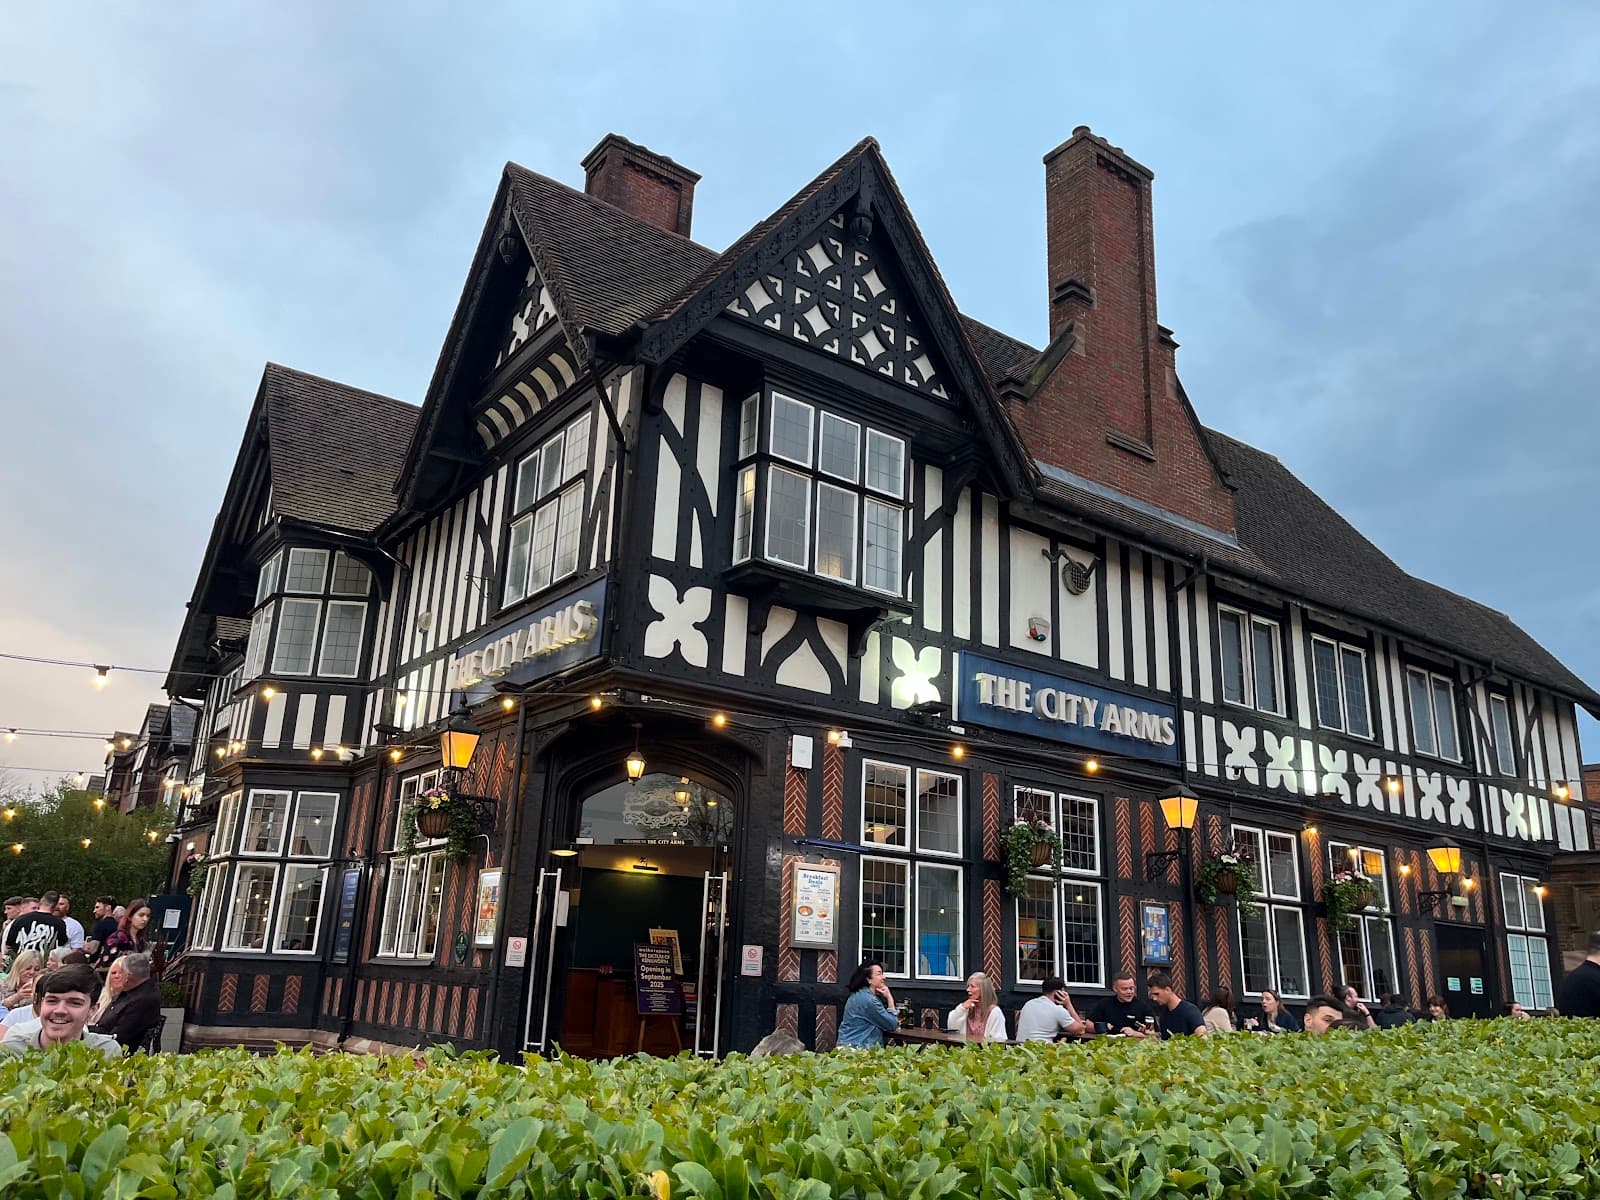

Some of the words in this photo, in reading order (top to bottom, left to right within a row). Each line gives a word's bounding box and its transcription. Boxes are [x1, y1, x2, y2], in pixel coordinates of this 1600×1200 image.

[449, 650, 483, 689] THE
[482, 629, 528, 676] CITY
[523, 599, 595, 658] ARMS
[975, 672, 1033, 714] THE
[1035, 687, 1099, 728] CITY
[1100, 703, 1176, 746] ARMS
[640, 965, 665, 974] Opening
[640, 972, 672, 981] September
